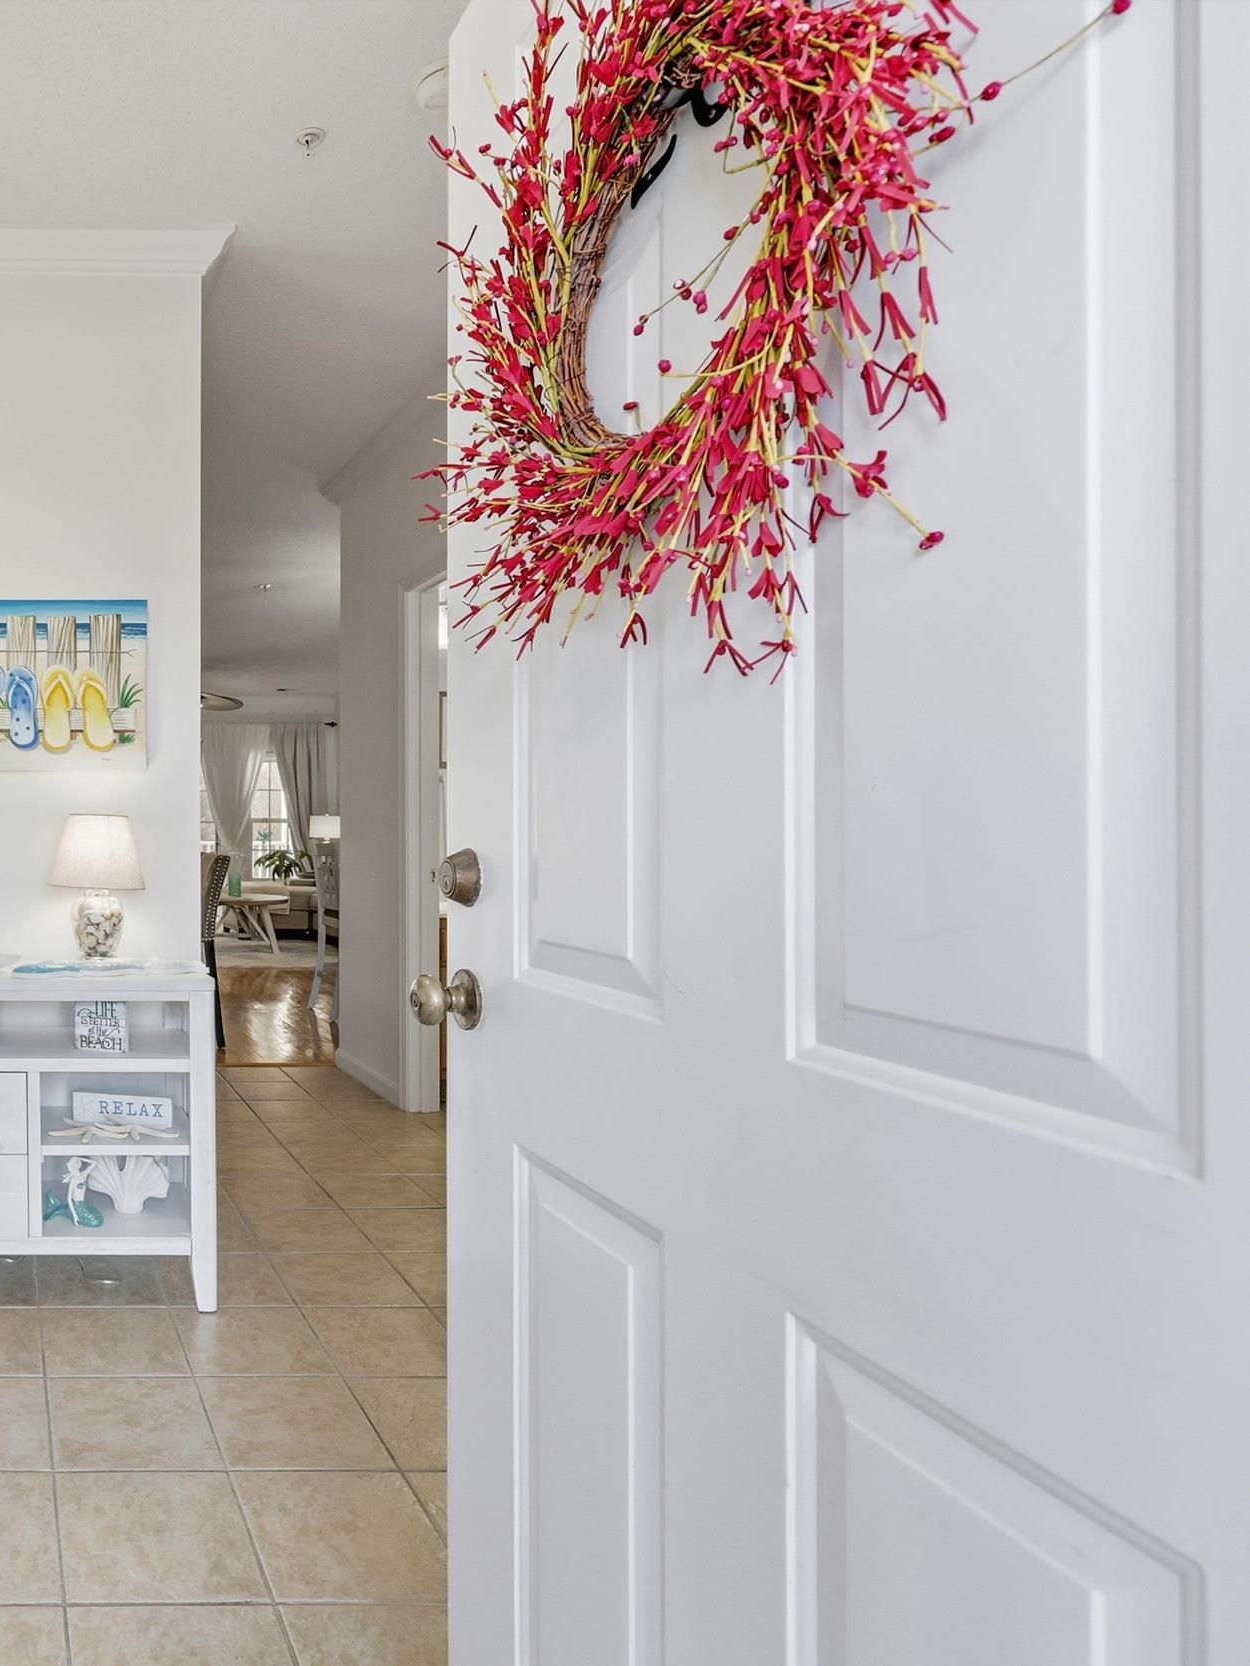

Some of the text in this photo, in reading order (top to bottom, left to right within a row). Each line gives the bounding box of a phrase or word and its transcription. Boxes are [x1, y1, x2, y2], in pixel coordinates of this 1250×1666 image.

[95, 1001, 117, 1018] LIFE
[80, 1034, 122, 1050] BEACH
[98, 1101, 163, 1118] RELAX
